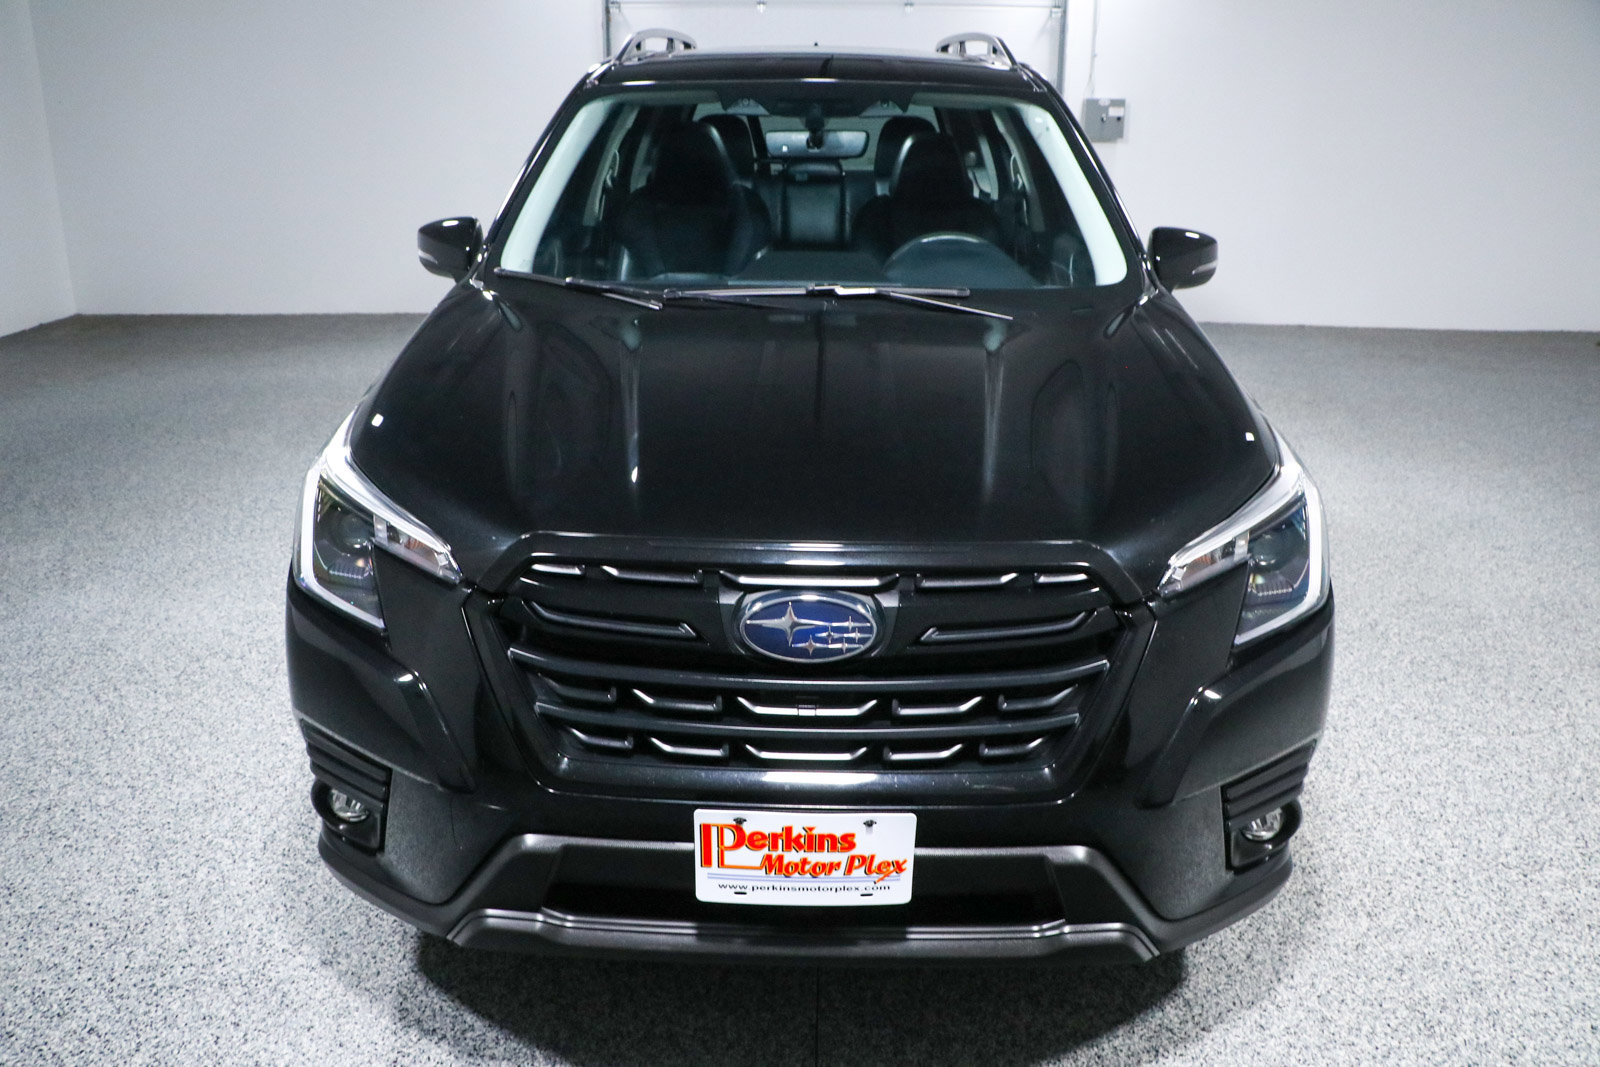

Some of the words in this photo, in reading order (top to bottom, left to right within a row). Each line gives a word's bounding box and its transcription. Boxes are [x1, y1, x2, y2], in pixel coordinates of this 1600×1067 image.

[700, 823, 857, 868] Perkins
[760, 854, 842, 877] Motor
[844, 855, 907, 884] Plex
[718, 882, 891, 893] www.perkinsmotorplex.com
